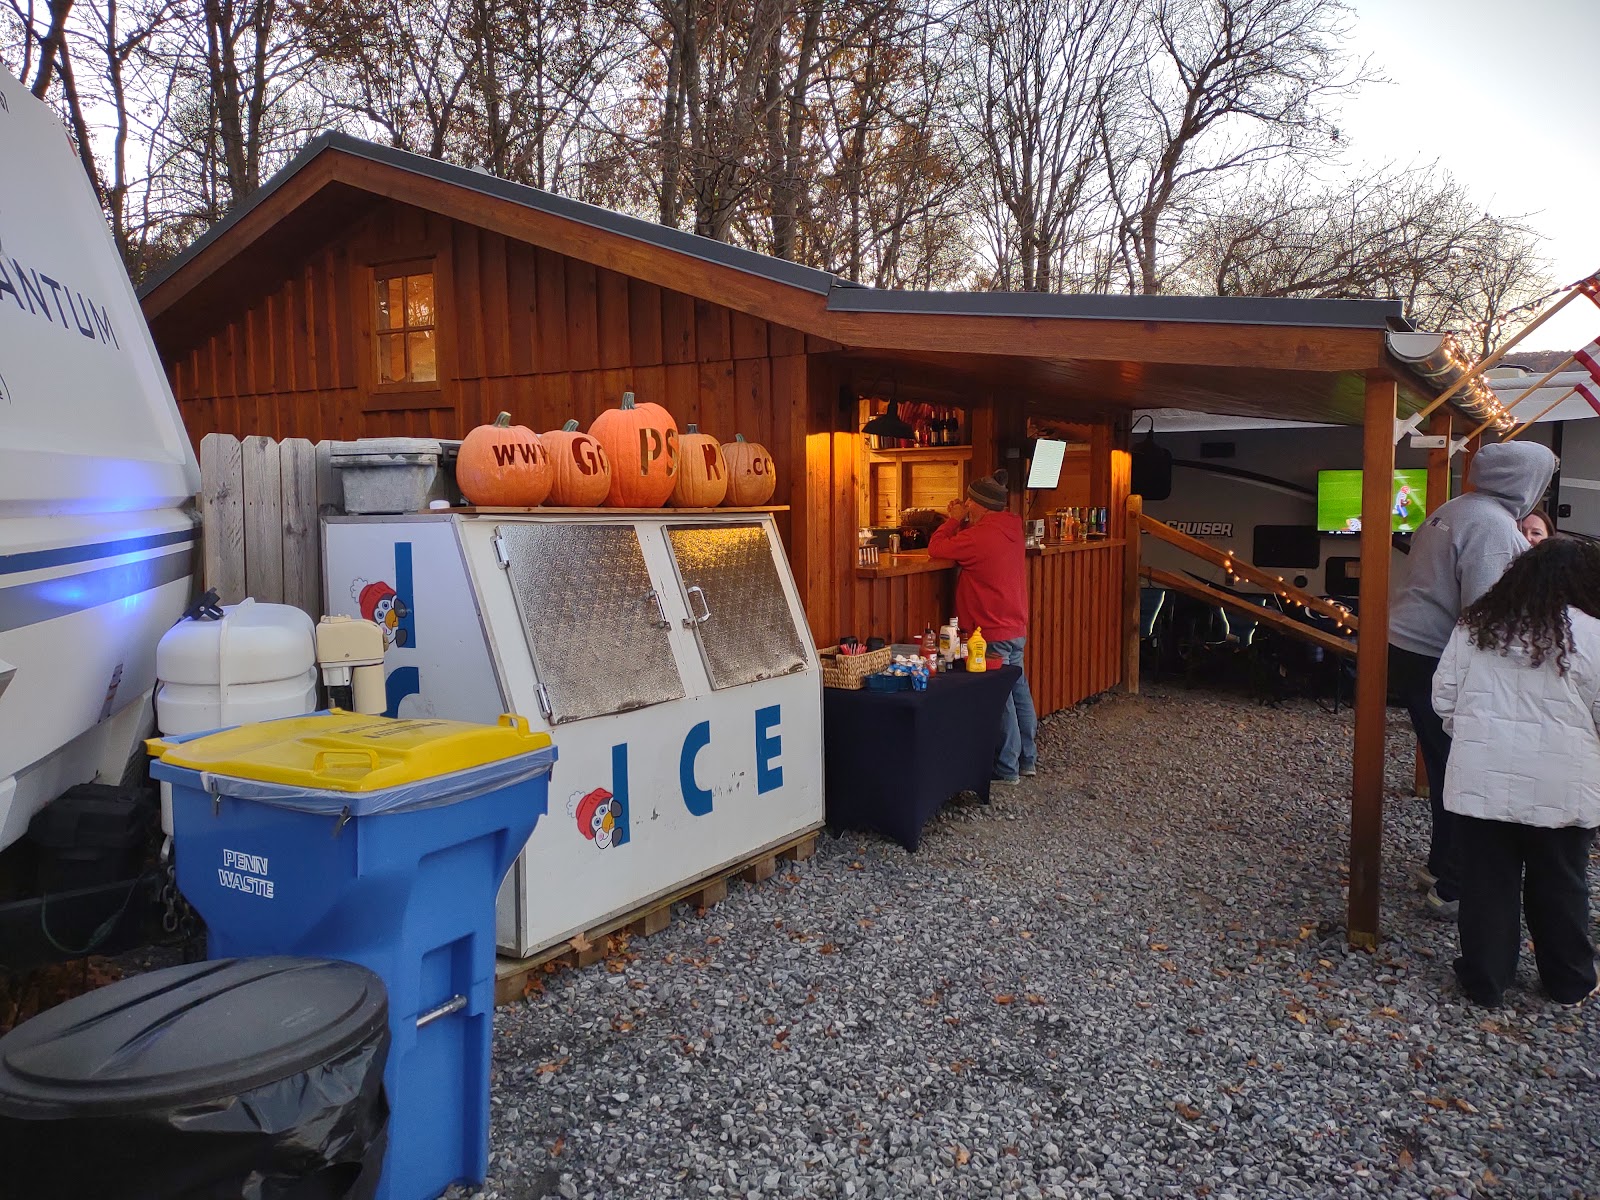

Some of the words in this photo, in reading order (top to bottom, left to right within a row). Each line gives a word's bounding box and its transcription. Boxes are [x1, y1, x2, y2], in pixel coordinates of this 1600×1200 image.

[611, 704, 784, 849] ICE
[223, 848, 268, 876] PENN
[218, 868, 274, 899] WASTE
